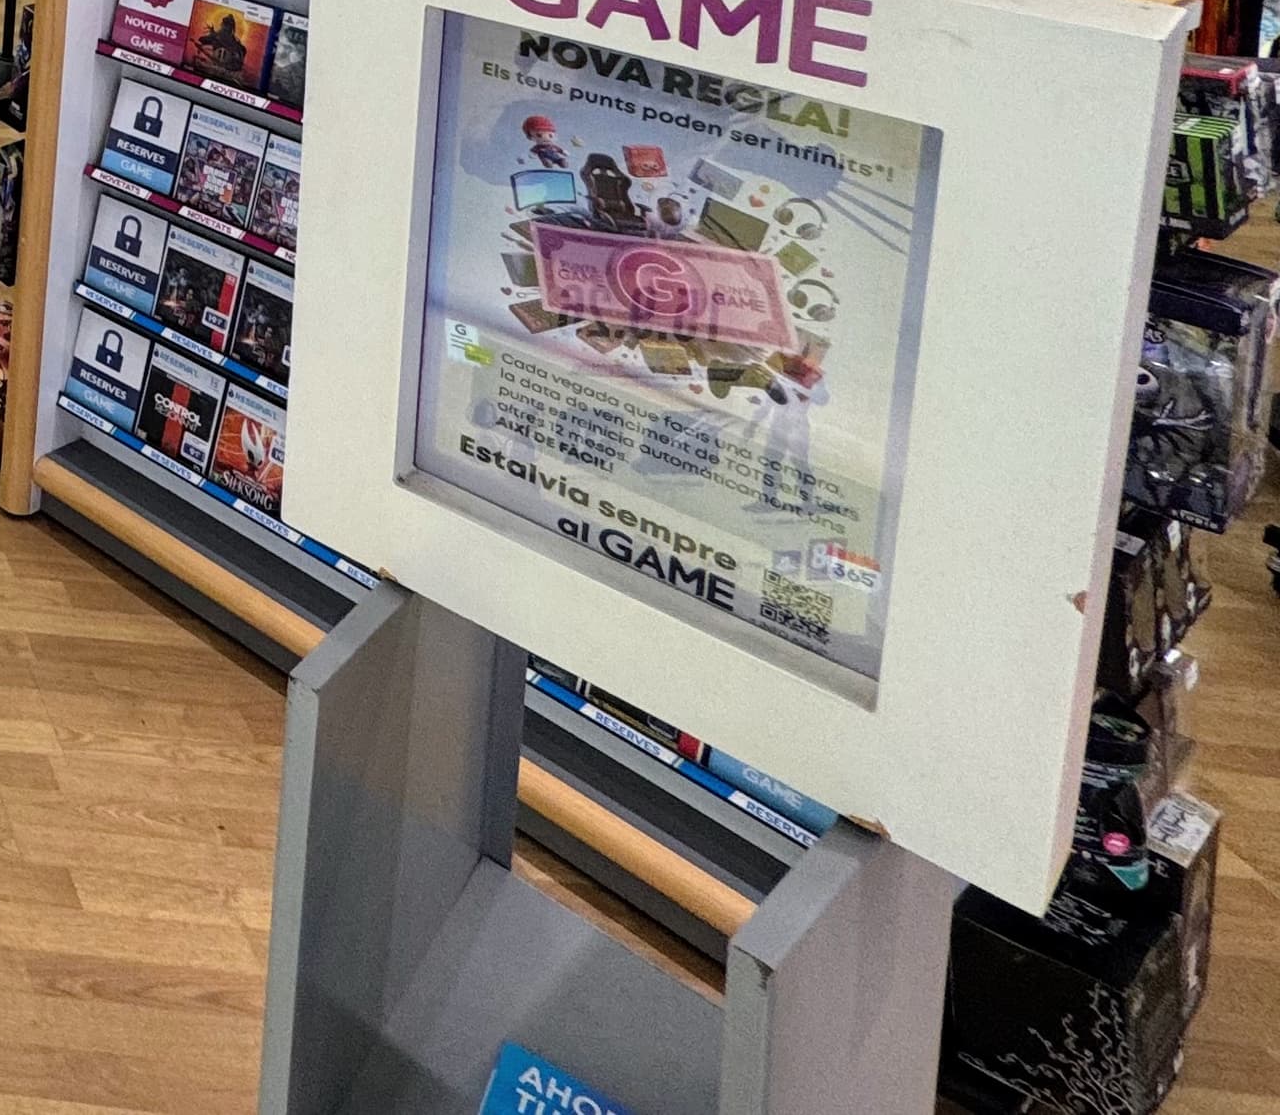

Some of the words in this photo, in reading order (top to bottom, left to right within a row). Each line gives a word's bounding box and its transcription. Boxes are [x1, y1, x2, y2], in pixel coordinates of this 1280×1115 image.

[124, 14, 178, 39] NOVETATS
[130, 36, 164, 54] GAME
[209, 83, 257, 105] NOVETATS
[518, 31, 651, 89] NOVA
[662, 66, 850, 139] REGLA!
[482, 61, 512, 82] Els
[516, 70, 564, 96] teus
[569, 86, 637, 116] punts
[643, 104, 723, 139] poden
[730, 128, 771, 150] ser
[116, 137, 166, 166] RESERVES
[120, 158, 153, 181] GAME
[187, 207, 233, 235] NOVETATS
[98, 256, 146, 286] RESERVES
[83, 289, 125, 314] RESERVES
[170, 332, 214, 359] RESERVES
[79, 368, 128, 401] RESERVES
[153, 392, 203, 427] CONTROL
[497, 401, 545, 427] altres
[550, 421, 565, 437] 12
[501, 352, 548, 379] Cada
[553, 368, 620, 407] vegada
[624, 401, 659, 424] que
[664, 415, 710, 443] facis
[714, 438, 752, 460] una
[495, 415, 532, 437] AIXÍ
[534, 431, 556, 450] DE
[558, 438, 615, 474] FÀCIL!
[499, 387, 545, 413] punts
[549, 404, 568, 421] es
[571, 412, 635, 448] reinicia
[639, 443, 802, 518] automàticament
[808, 510, 847, 535] uns
[500, 367, 515, 383] la
[519, 376, 561, 401] data
[566, 391, 588, 411] de
[593, 406, 692, 455] venciment
[695, 445, 720, 465] de
[724, 458, 775, 488] TOTS
[779, 483, 810, 502] els
[815, 495, 860, 523] teus
[149, 451, 193, 480] RESERVES
[221, 471, 274, 511] SILKSONG
[460, 434, 590, 508] Estalvia
[598, 496, 738, 572] sempre
[243, 506, 290, 538] RESERVES
[557, 514, 590, 547] al
[598, 527, 736, 612] GAME
[832, 562, 875, 588] 365
[595, 710, 661, 757] RESERVES
[742, 766, 805, 810] GAME
[518, 1066, 617, 1115] AHO
